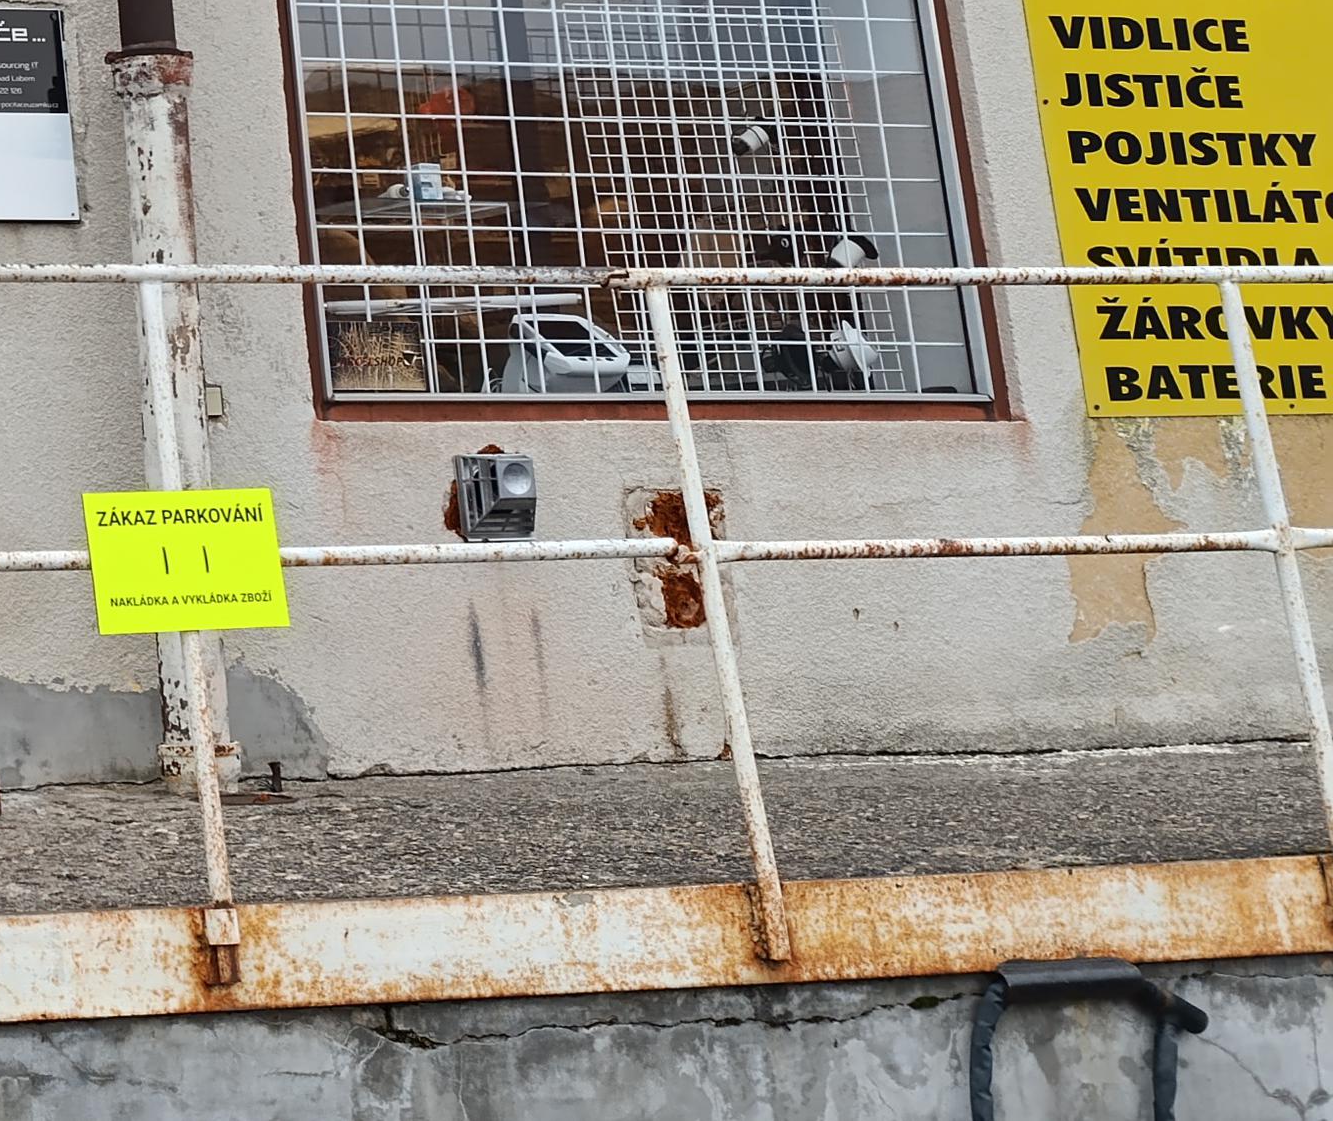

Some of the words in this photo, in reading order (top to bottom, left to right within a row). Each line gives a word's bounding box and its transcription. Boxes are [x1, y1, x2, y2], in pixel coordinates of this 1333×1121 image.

[1048, 15, 1250, 53] VIDLICE
[1060, 67, 1244, 109] JISTIČE
[1067, 130, 1317, 167] POJISTKY
[1074, 181, 1333, 224] VENTILÁT
[1105, 364, 1327, 401] BATERIE
[97, 506, 157, 527] ZÁKAZ
[162, 503, 263, 524] PARKOVÁNÍ
[110, 593, 169, 607] NAKLÁDKA
[171, 595, 180, 605] A
[181, 591, 238, 605] VYKLÁDKA
[241, 590, 273, 603] ZBOŽÍ
